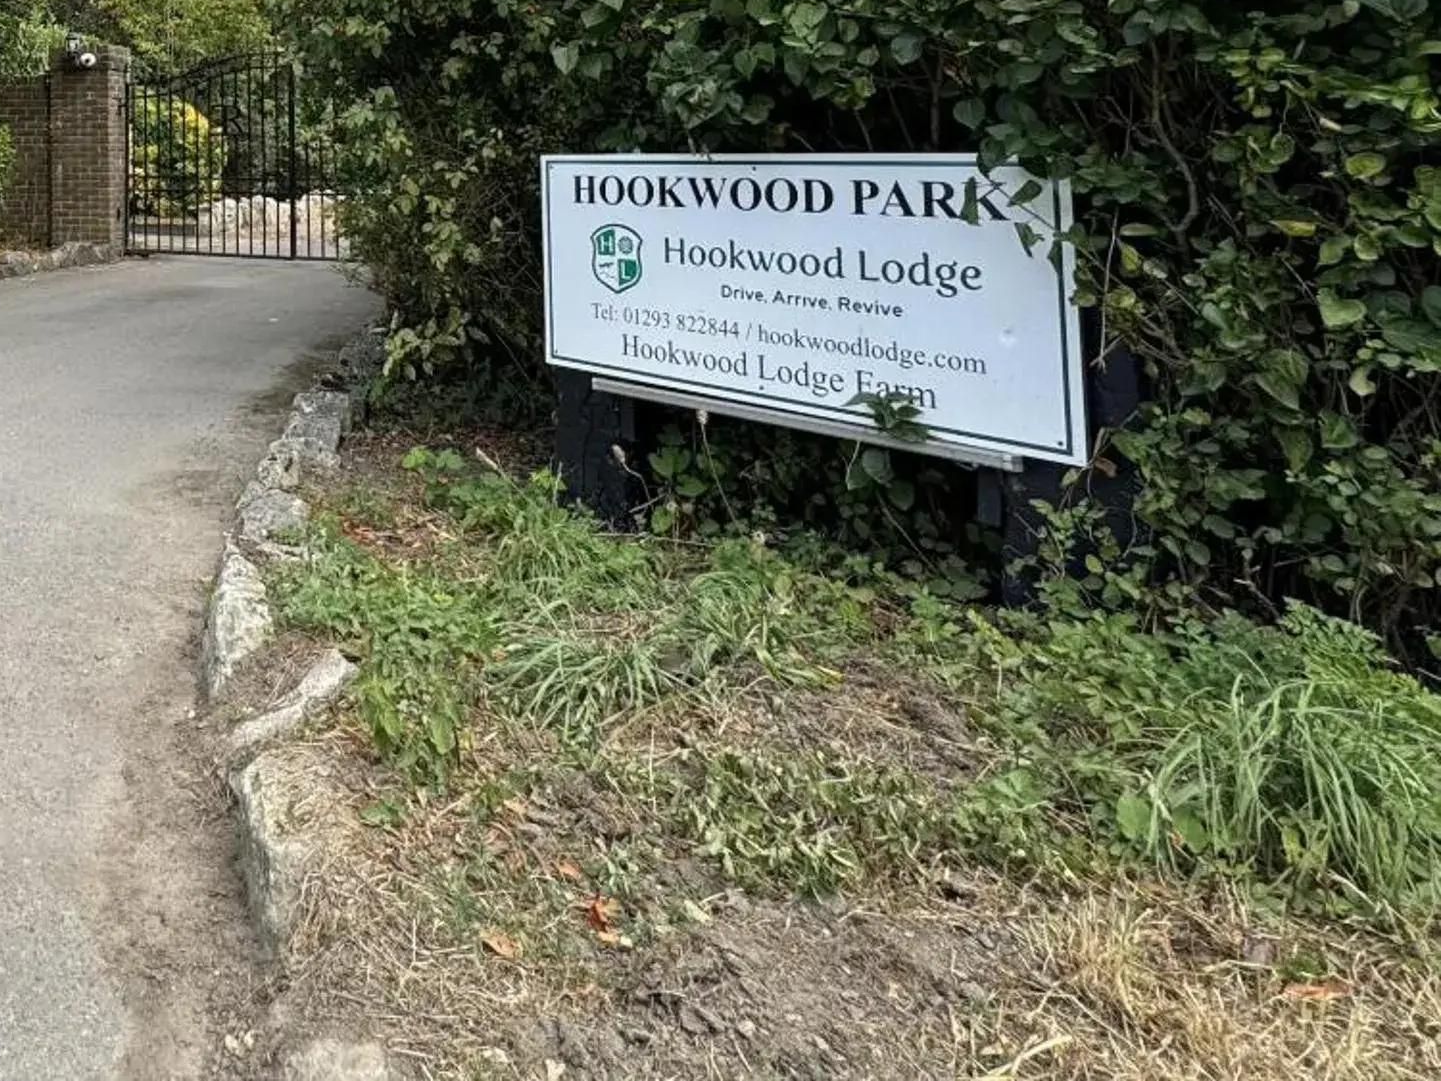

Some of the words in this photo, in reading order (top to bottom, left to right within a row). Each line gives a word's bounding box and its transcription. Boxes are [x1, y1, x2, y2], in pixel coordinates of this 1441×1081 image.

[574, 175, 834, 213] HOOKWOOD
[850, 178, 1012, 220] PARK
[601, 235, 613, 252] H
[664, 237, 845, 279] Hookwood
[859, 251, 983, 298] Lodge
[837, 296, 903, 318] Revive
[591, 303, 618, 322] Tel:
[623, 306, 670, 330] 01293
[676, 314, 739, 338] 822844
[745, 323, 752, 341] /
[758, 324, 987, 375] hookwoodlodge.com
[622, 334, 748, 377] Hookwood
[758, 354, 845, 397] Lodge
